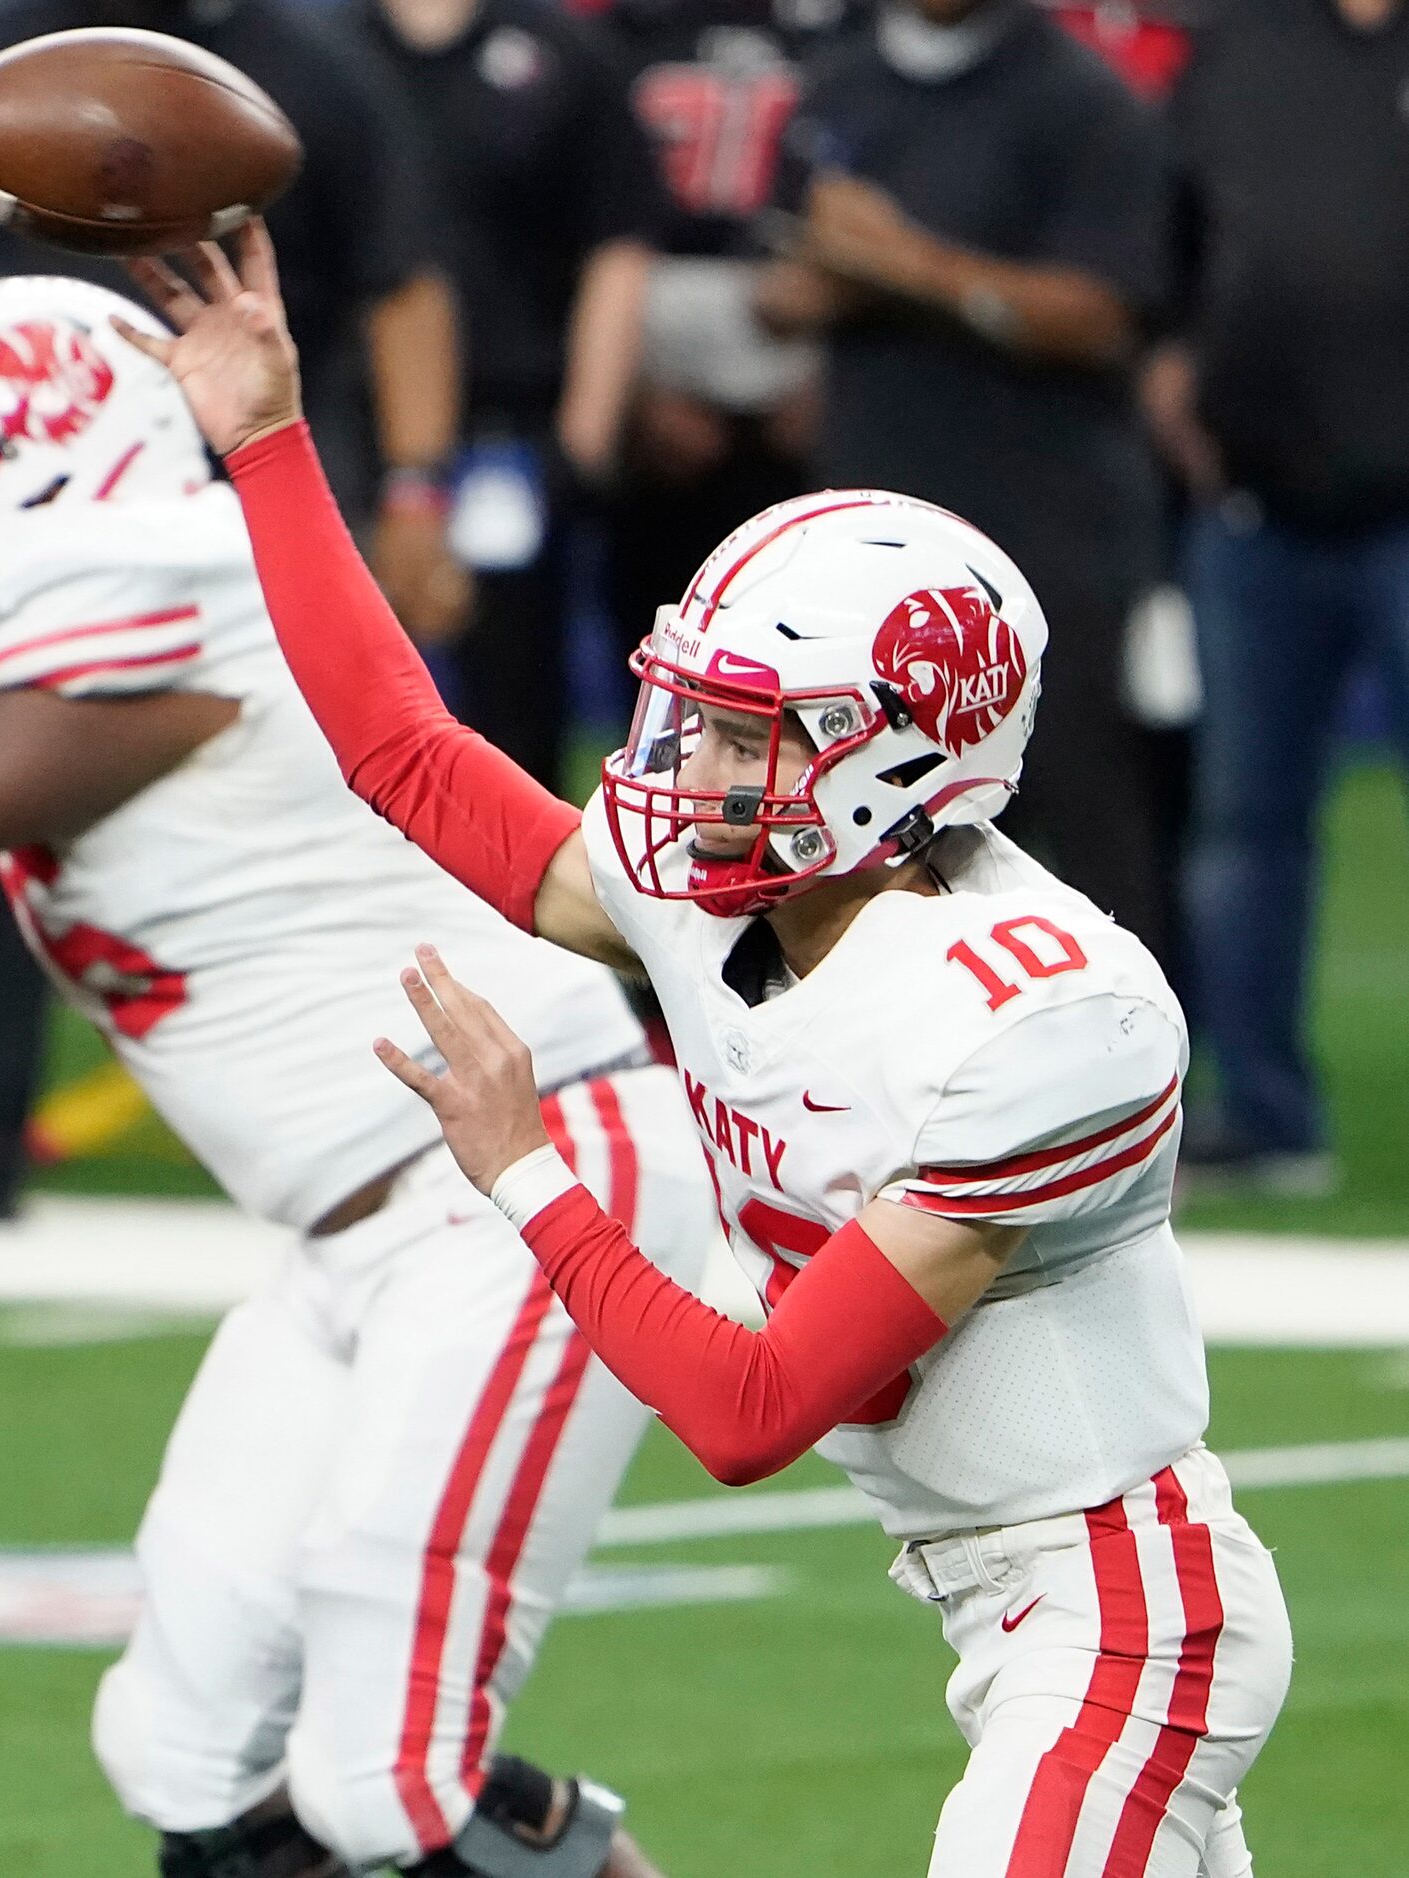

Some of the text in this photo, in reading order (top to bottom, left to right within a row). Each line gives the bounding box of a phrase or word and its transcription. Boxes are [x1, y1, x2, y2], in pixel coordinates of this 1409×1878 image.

[664, 621, 701, 658] Riddell
[959, 660, 1009, 708] KATY
[946, 914, 1089, 1013] 10
[683, 1067, 787, 1194] KATY
